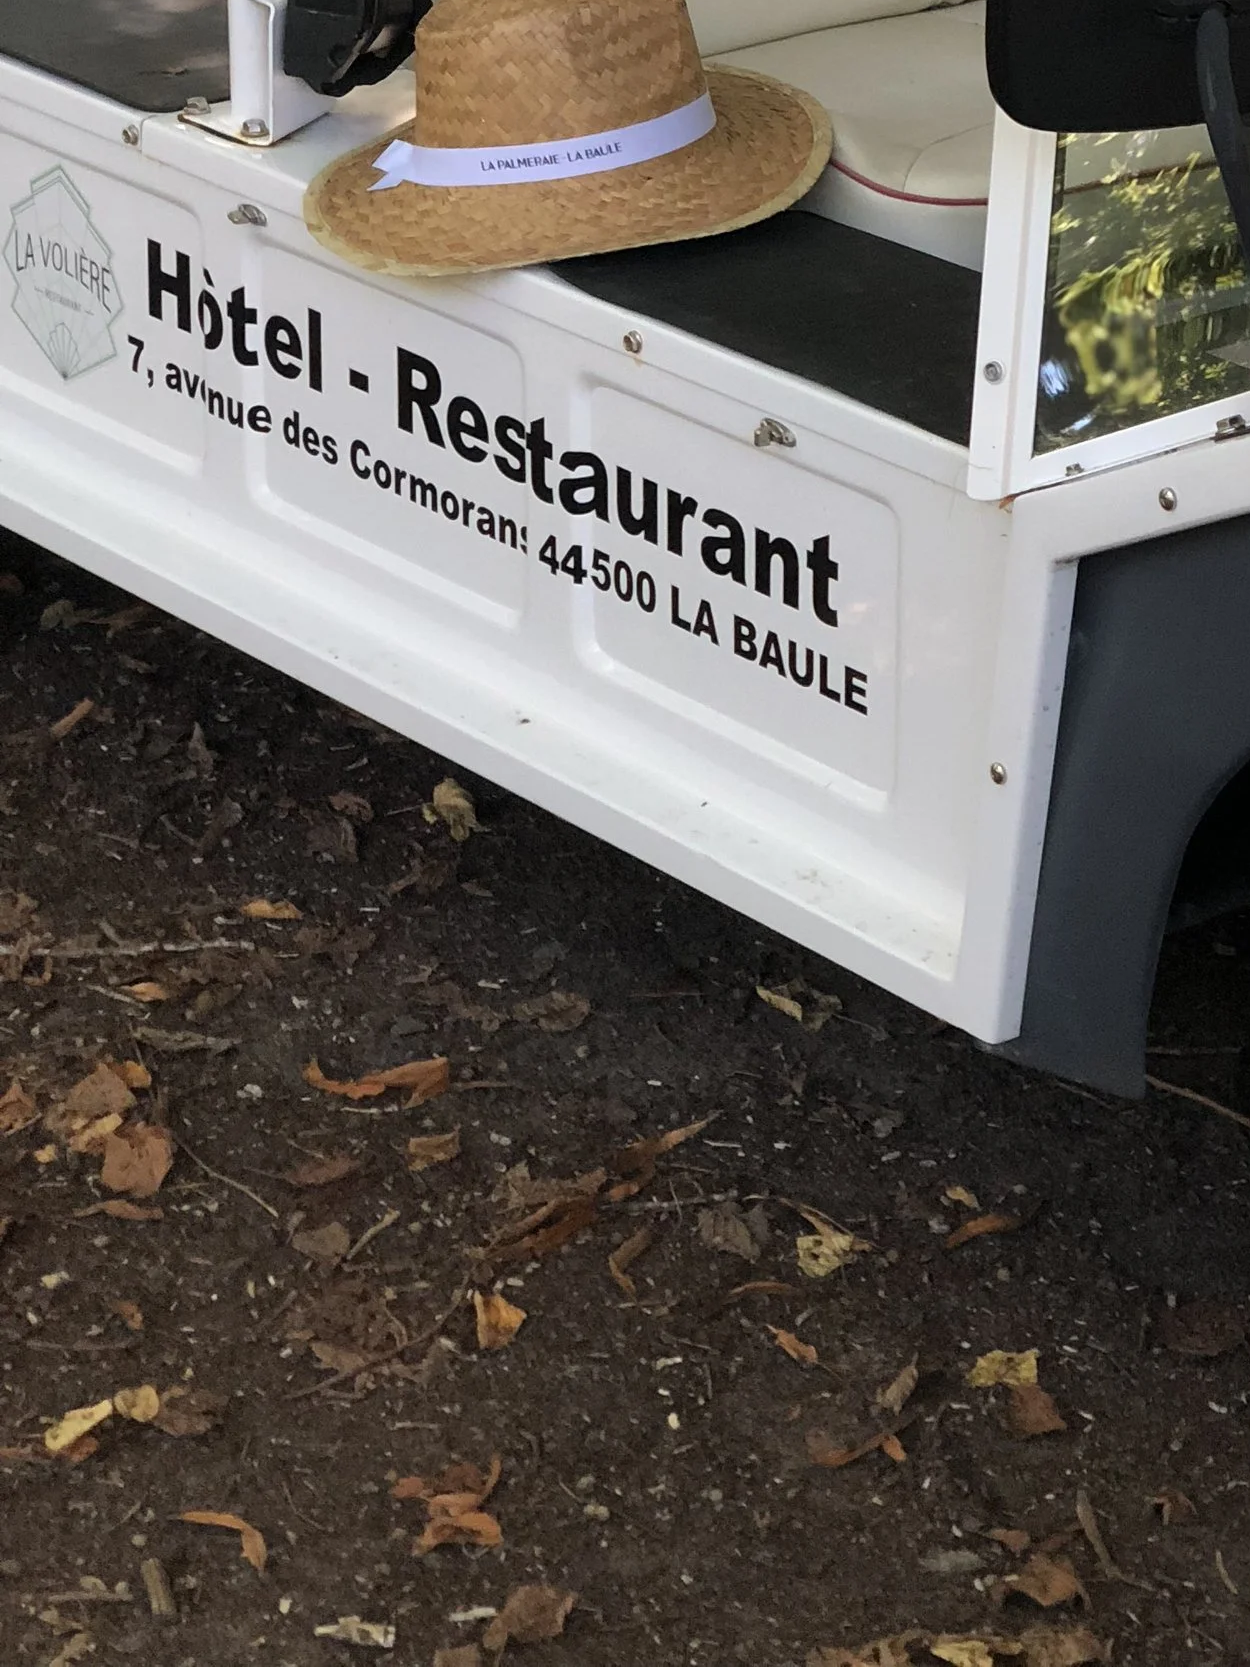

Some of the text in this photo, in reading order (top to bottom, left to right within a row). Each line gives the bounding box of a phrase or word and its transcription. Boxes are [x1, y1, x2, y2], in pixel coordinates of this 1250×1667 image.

[480, 160, 496, 172] LA
[497, 153, 560, 170] PALMERAIE
[567, 150, 585, 163] LA
[585, 141, 623, 160] BAULE
[14, 229, 36, 272] LA
[39, 236, 112, 314] VOLIÈRE
[283, 410, 339, 465] des
[538, 534, 657, 613] 44500
[671, 584, 719, 646] LA
[733, 614, 868, 716] BAULE
[396, 346, 839, 628] Restaurant
